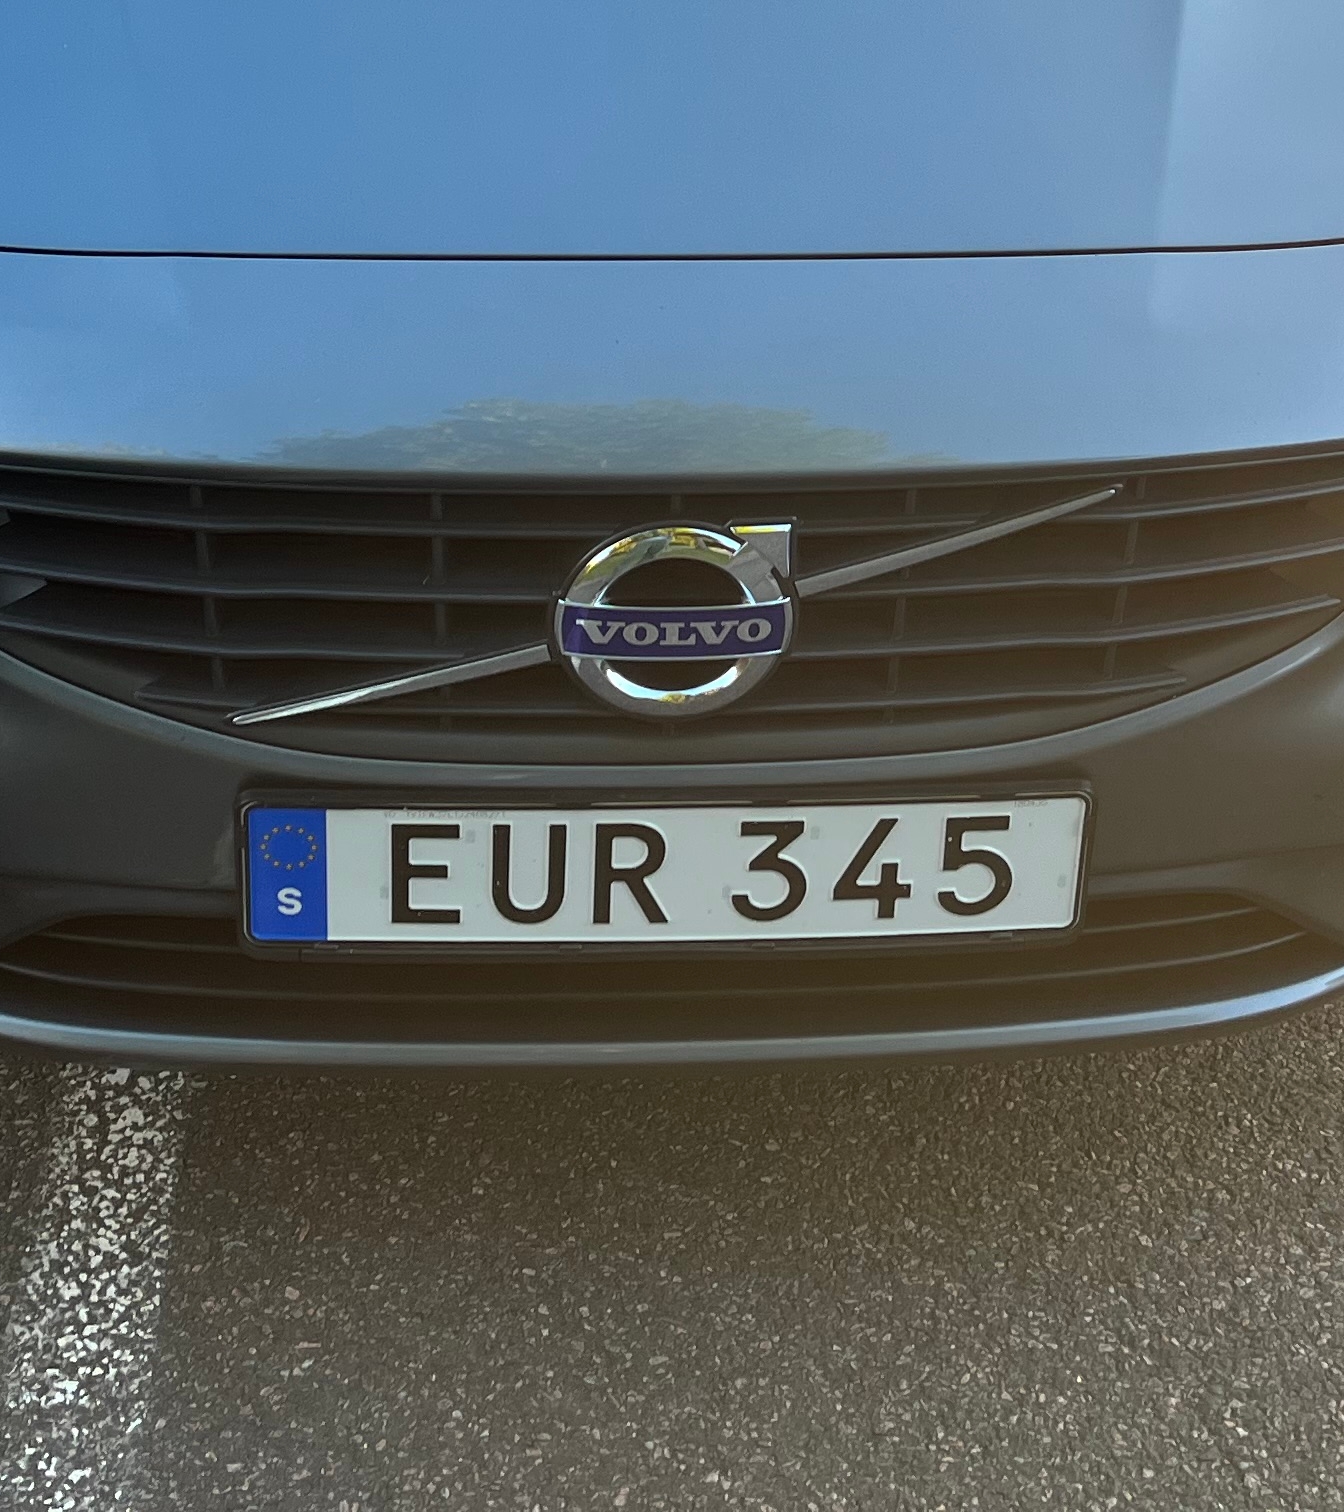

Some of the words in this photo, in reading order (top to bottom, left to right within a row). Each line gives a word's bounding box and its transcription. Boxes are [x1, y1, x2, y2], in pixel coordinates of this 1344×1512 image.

[575, 618, 772, 646] VOLVO
[392, 823, 669, 925] EUR
[731, 816, 1013, 922] 345
[277, 887, 303, 916] S
